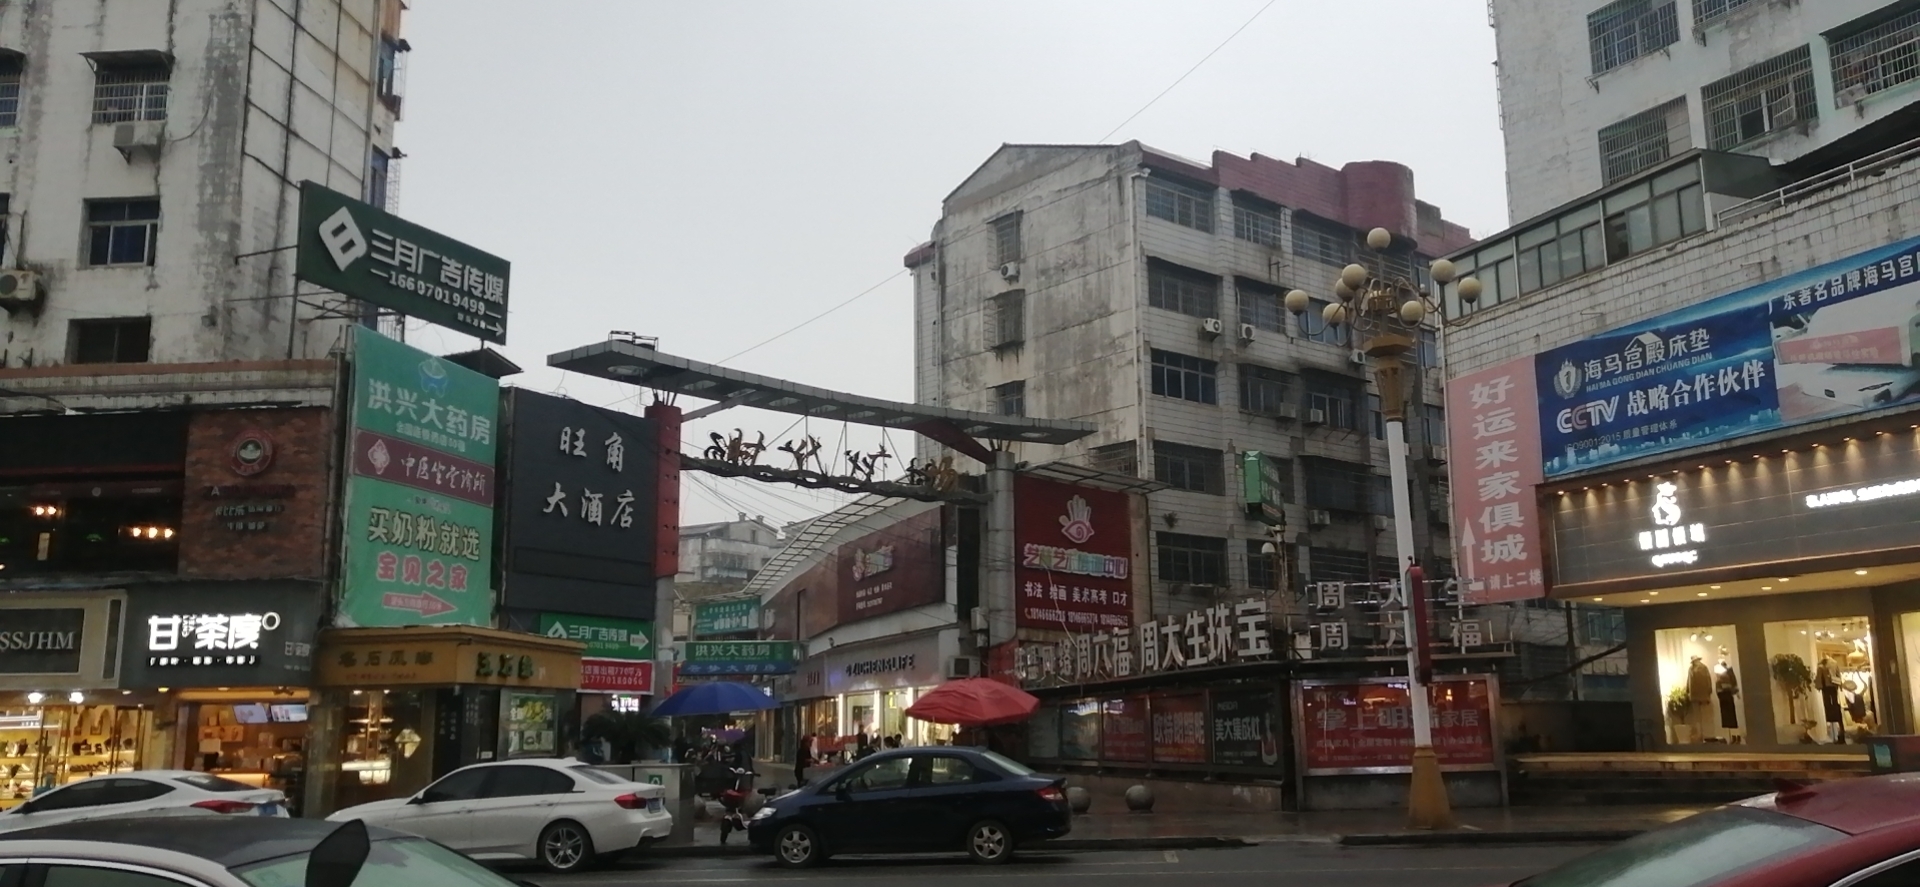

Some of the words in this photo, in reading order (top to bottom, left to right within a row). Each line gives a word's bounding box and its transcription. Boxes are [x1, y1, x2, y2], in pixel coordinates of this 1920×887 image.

[370, 228, 504, 305] 三月广告传媒
[1769, 251, 1920, 315] 广东著名品牌海马宫
[389, 271, 485, 316] 16607019499
[1584, 327, 1710, 382] 海马宫殿床垫
[1586, 382, 1599, 393] HAI
[1600, 380, 1611, 390] MA
[1612, 373, 1634, 387] GONG
[1635, 369, 1654, 382] DIAN
[1656, 358, 1691, 378] CHUANG
[1692, 352, 1713, 367] DIAN
[367, 378, 492, 445] 洪兴大药房
[1557, 395, 1620, 434] CCTV
[1627, 359, 1765, 417] 战略合作伙伴
[560, 426, 624, 472] 旺角
[1469, 375, 1527, 564] 好运来家俱城
[543, 481, 635, 528] 大酒店
[367, 506, 480, 562] 买奶粉就选
[376, 551, 468, 592] 宝贝之家
[1024, 581, 1043, 598] 书法
[1050, 585, 1067, 601] 绘画
[1072, 587, 1108, 605] 美术高考
[1113, 591, 1128, 606] 口才
[0, 631, 75, 652] SSJHM
[148, 613, 263, 650] 甘茶度
[695, 644, 770, 657] 洪兴大药房
[1076, 627, 1132, 679] 周六福
[1140, 598, 1272, 672] 周大生珠宝
[1215, 716, 1261, 741] 美大集成灶
